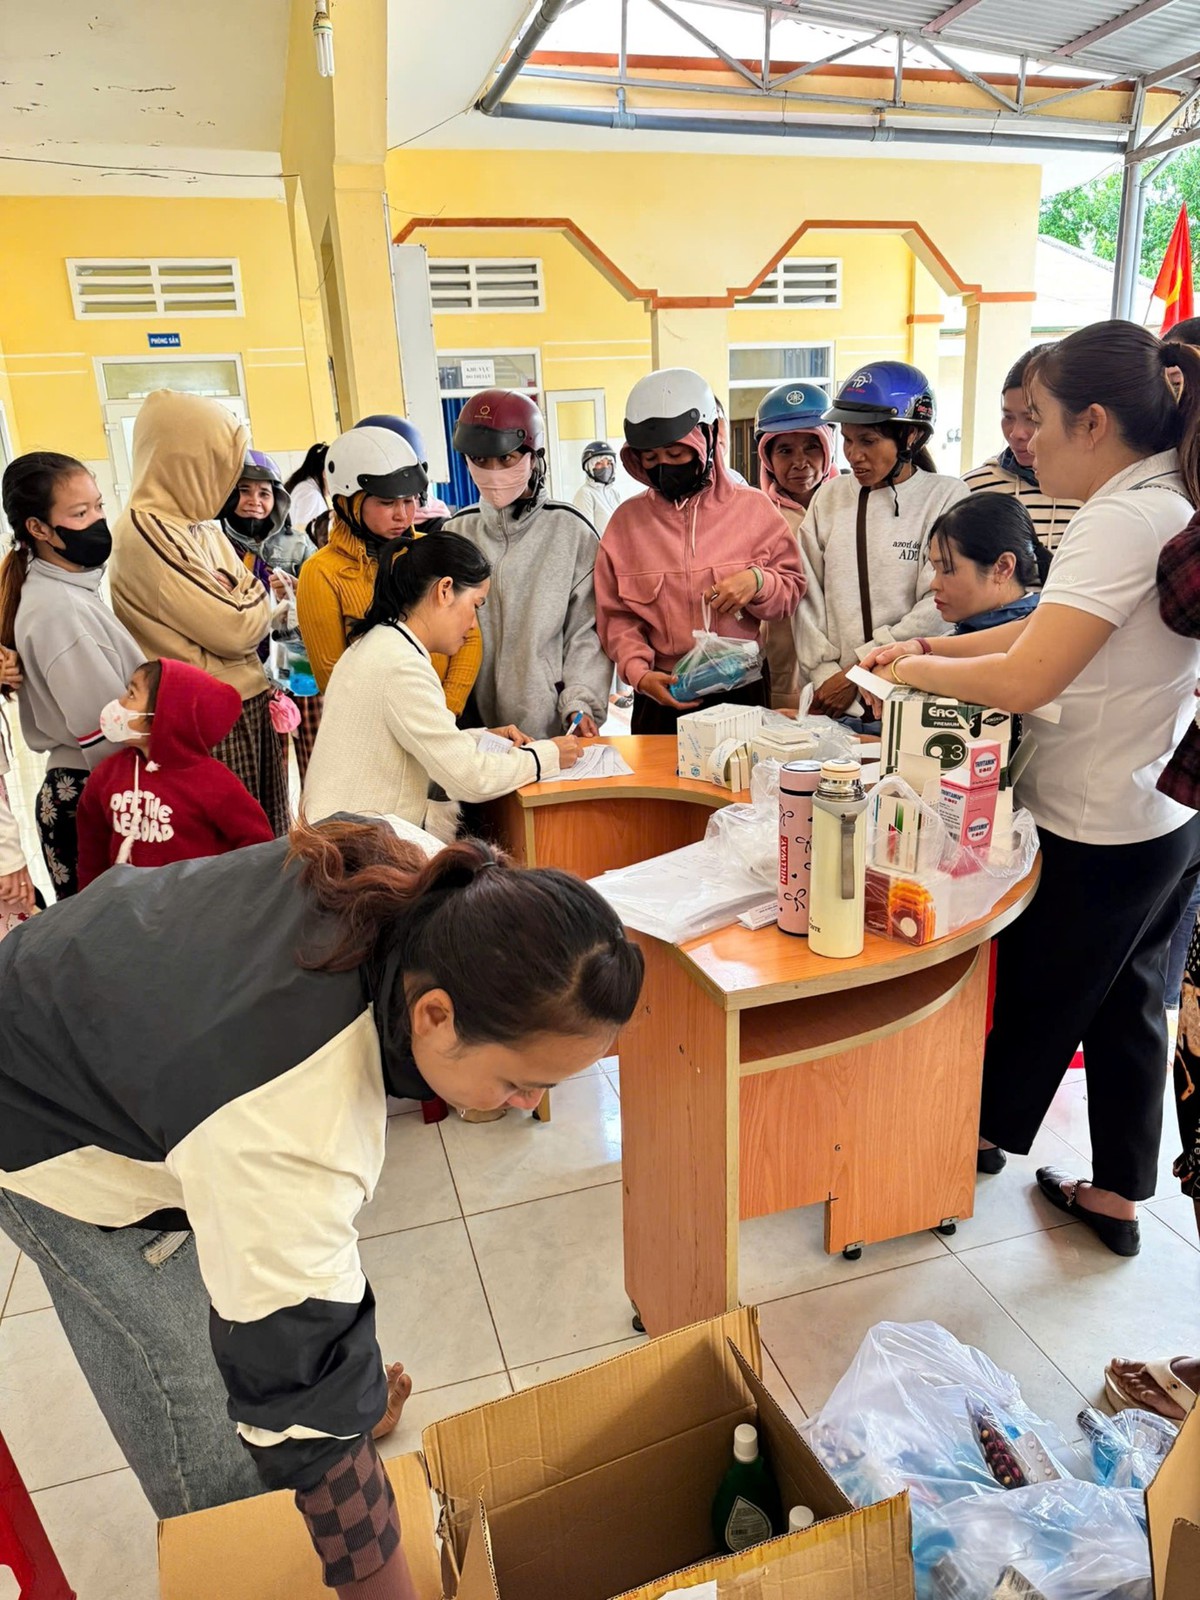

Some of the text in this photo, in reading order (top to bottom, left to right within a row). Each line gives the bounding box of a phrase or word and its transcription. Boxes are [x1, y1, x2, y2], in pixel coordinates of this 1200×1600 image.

[933, 721, 960, 729] PREMIUM
[110, 789, 173, 823] OFF THE
